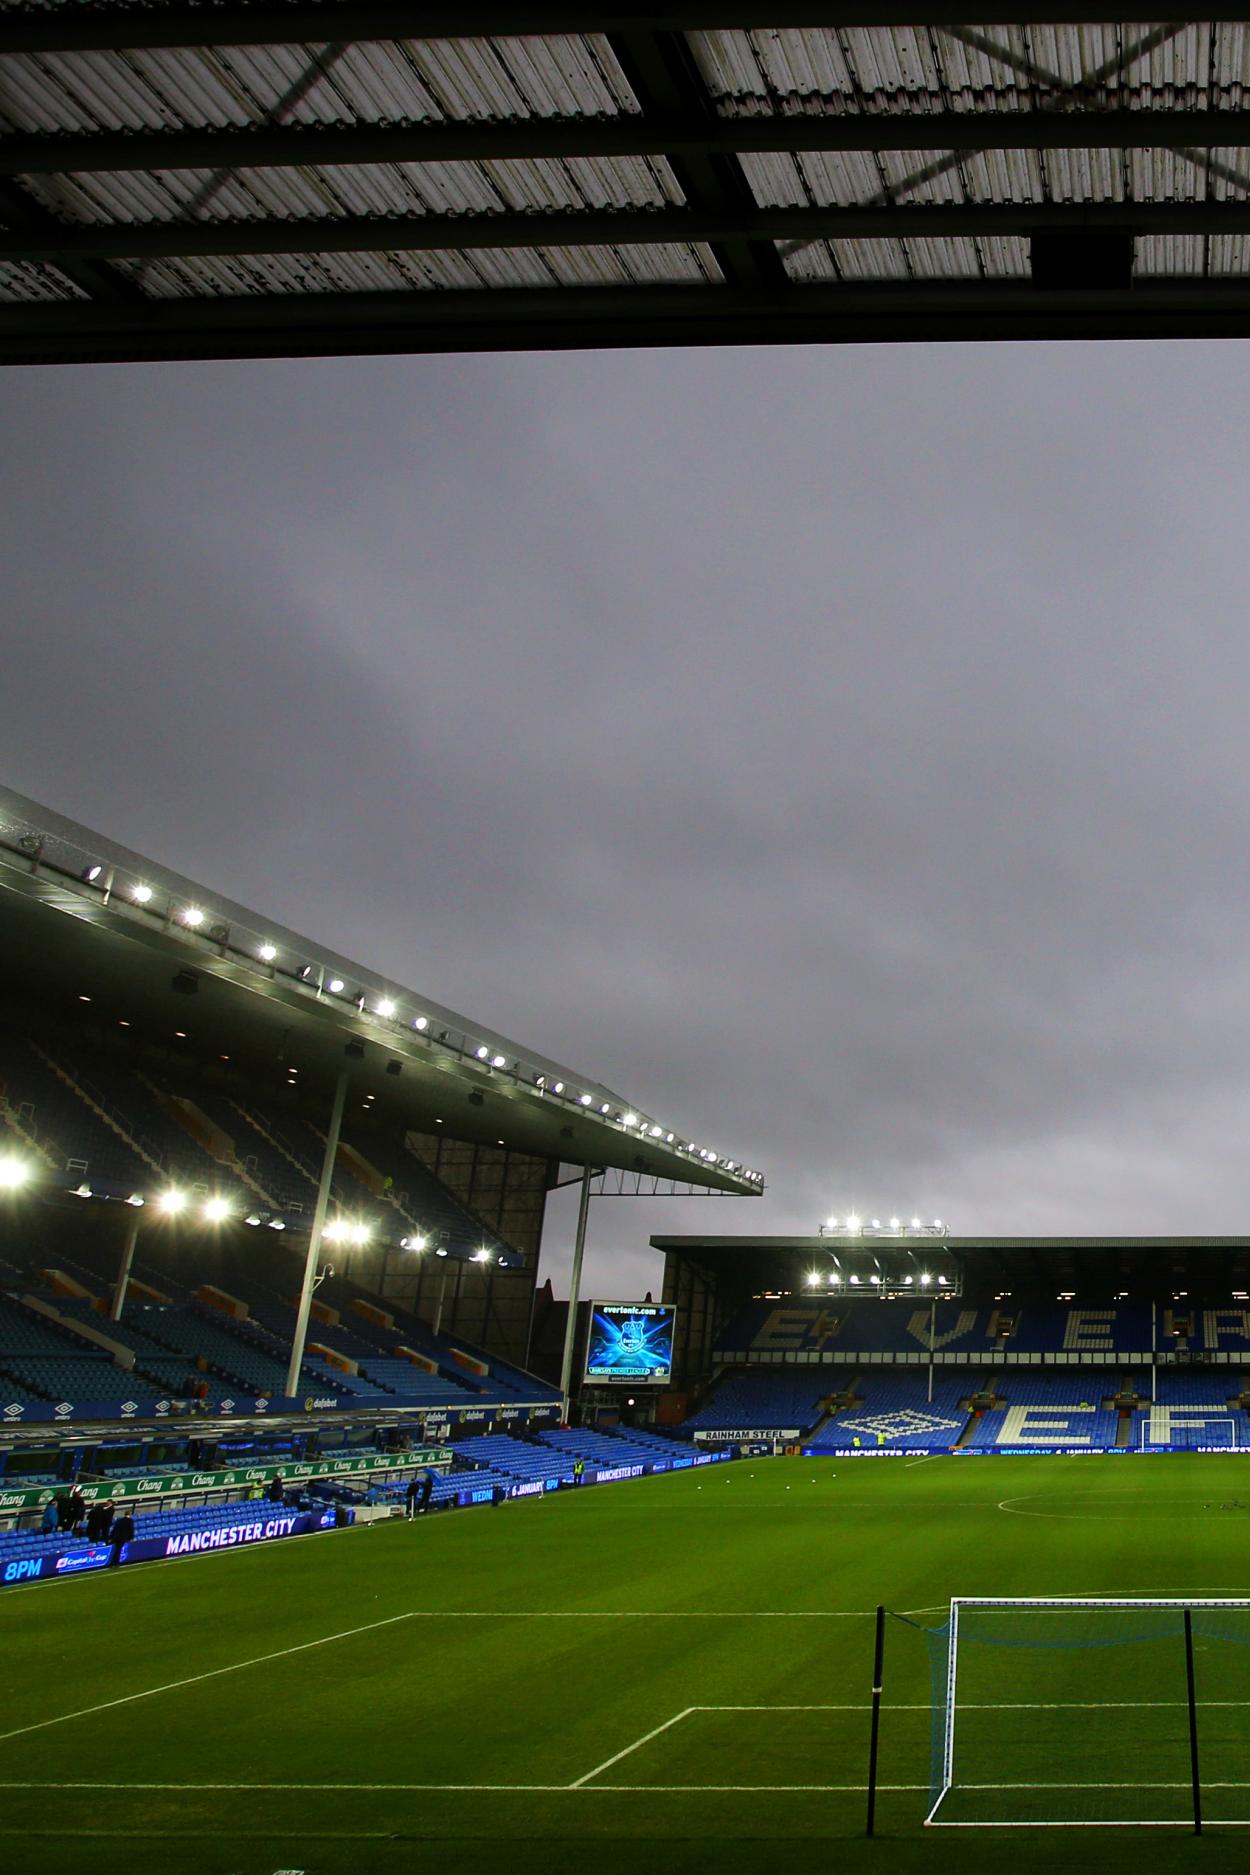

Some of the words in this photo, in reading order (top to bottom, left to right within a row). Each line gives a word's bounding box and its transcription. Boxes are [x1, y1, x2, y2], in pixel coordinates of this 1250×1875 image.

[706, 1430, 750, 1440] RAINHAM
[753, 1430, 785, 1439] STEEL
[245, 1468, 267, 1480] Chang
[596, 1466, 632, 1482] MANCHESTER
[632, 1464, 644, 1476] CITY
[137, 1479, 163, 1492] Chang
[191, 1474, 216, 1486] Chang
[166, 1522, 262, 1555] MANCHESTER
[265, 1517, 297, 1538] CITY
[4, 1558, 42, 1580] 8PM
